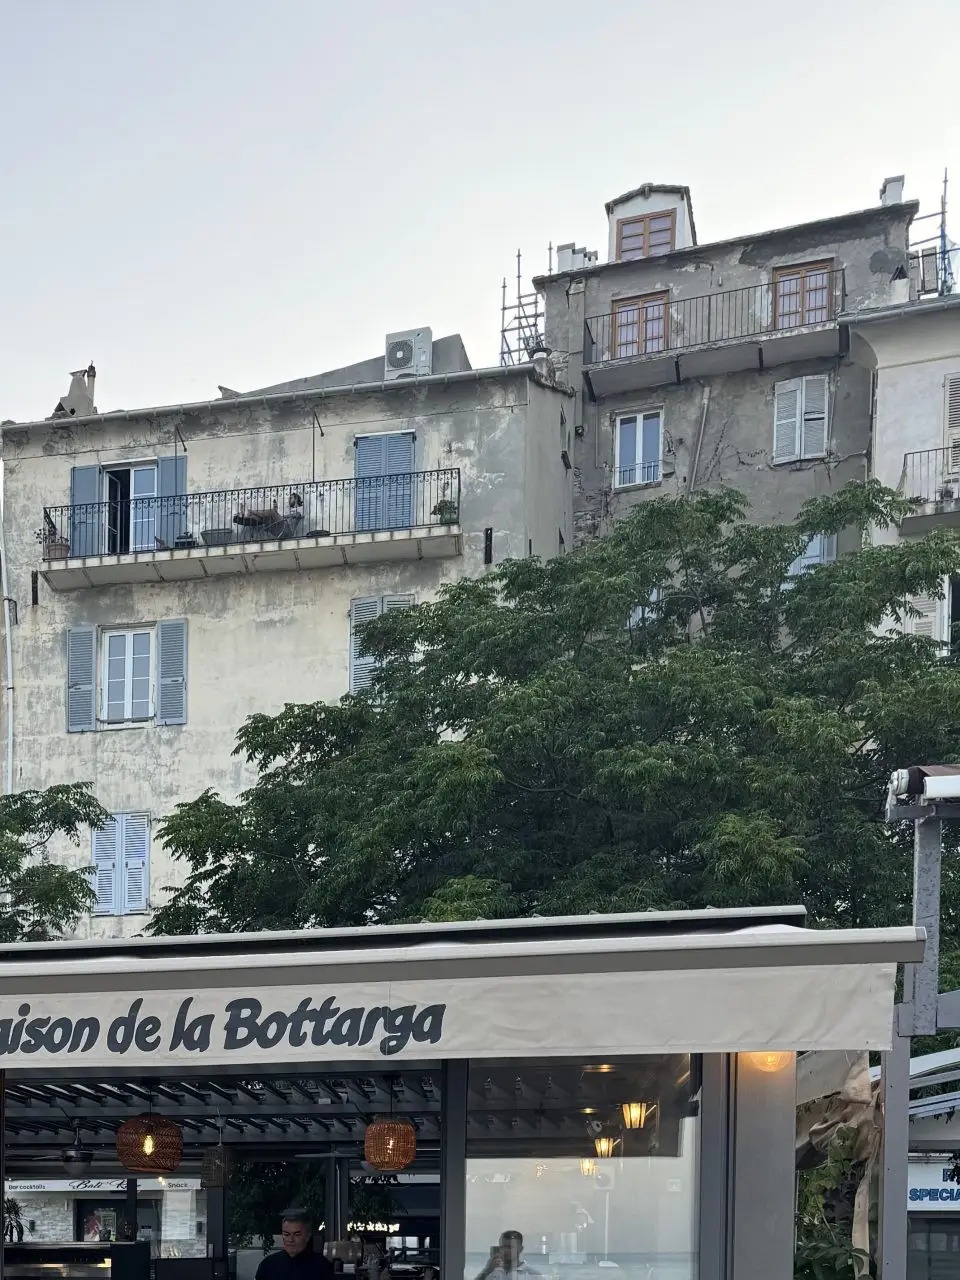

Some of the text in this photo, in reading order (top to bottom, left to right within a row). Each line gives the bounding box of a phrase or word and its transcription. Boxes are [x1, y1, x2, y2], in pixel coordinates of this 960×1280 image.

[106, 998, 162, 1055] de
[170, 996, 215, 1052] la
[223, 995, 446, 1056] Bottarga
